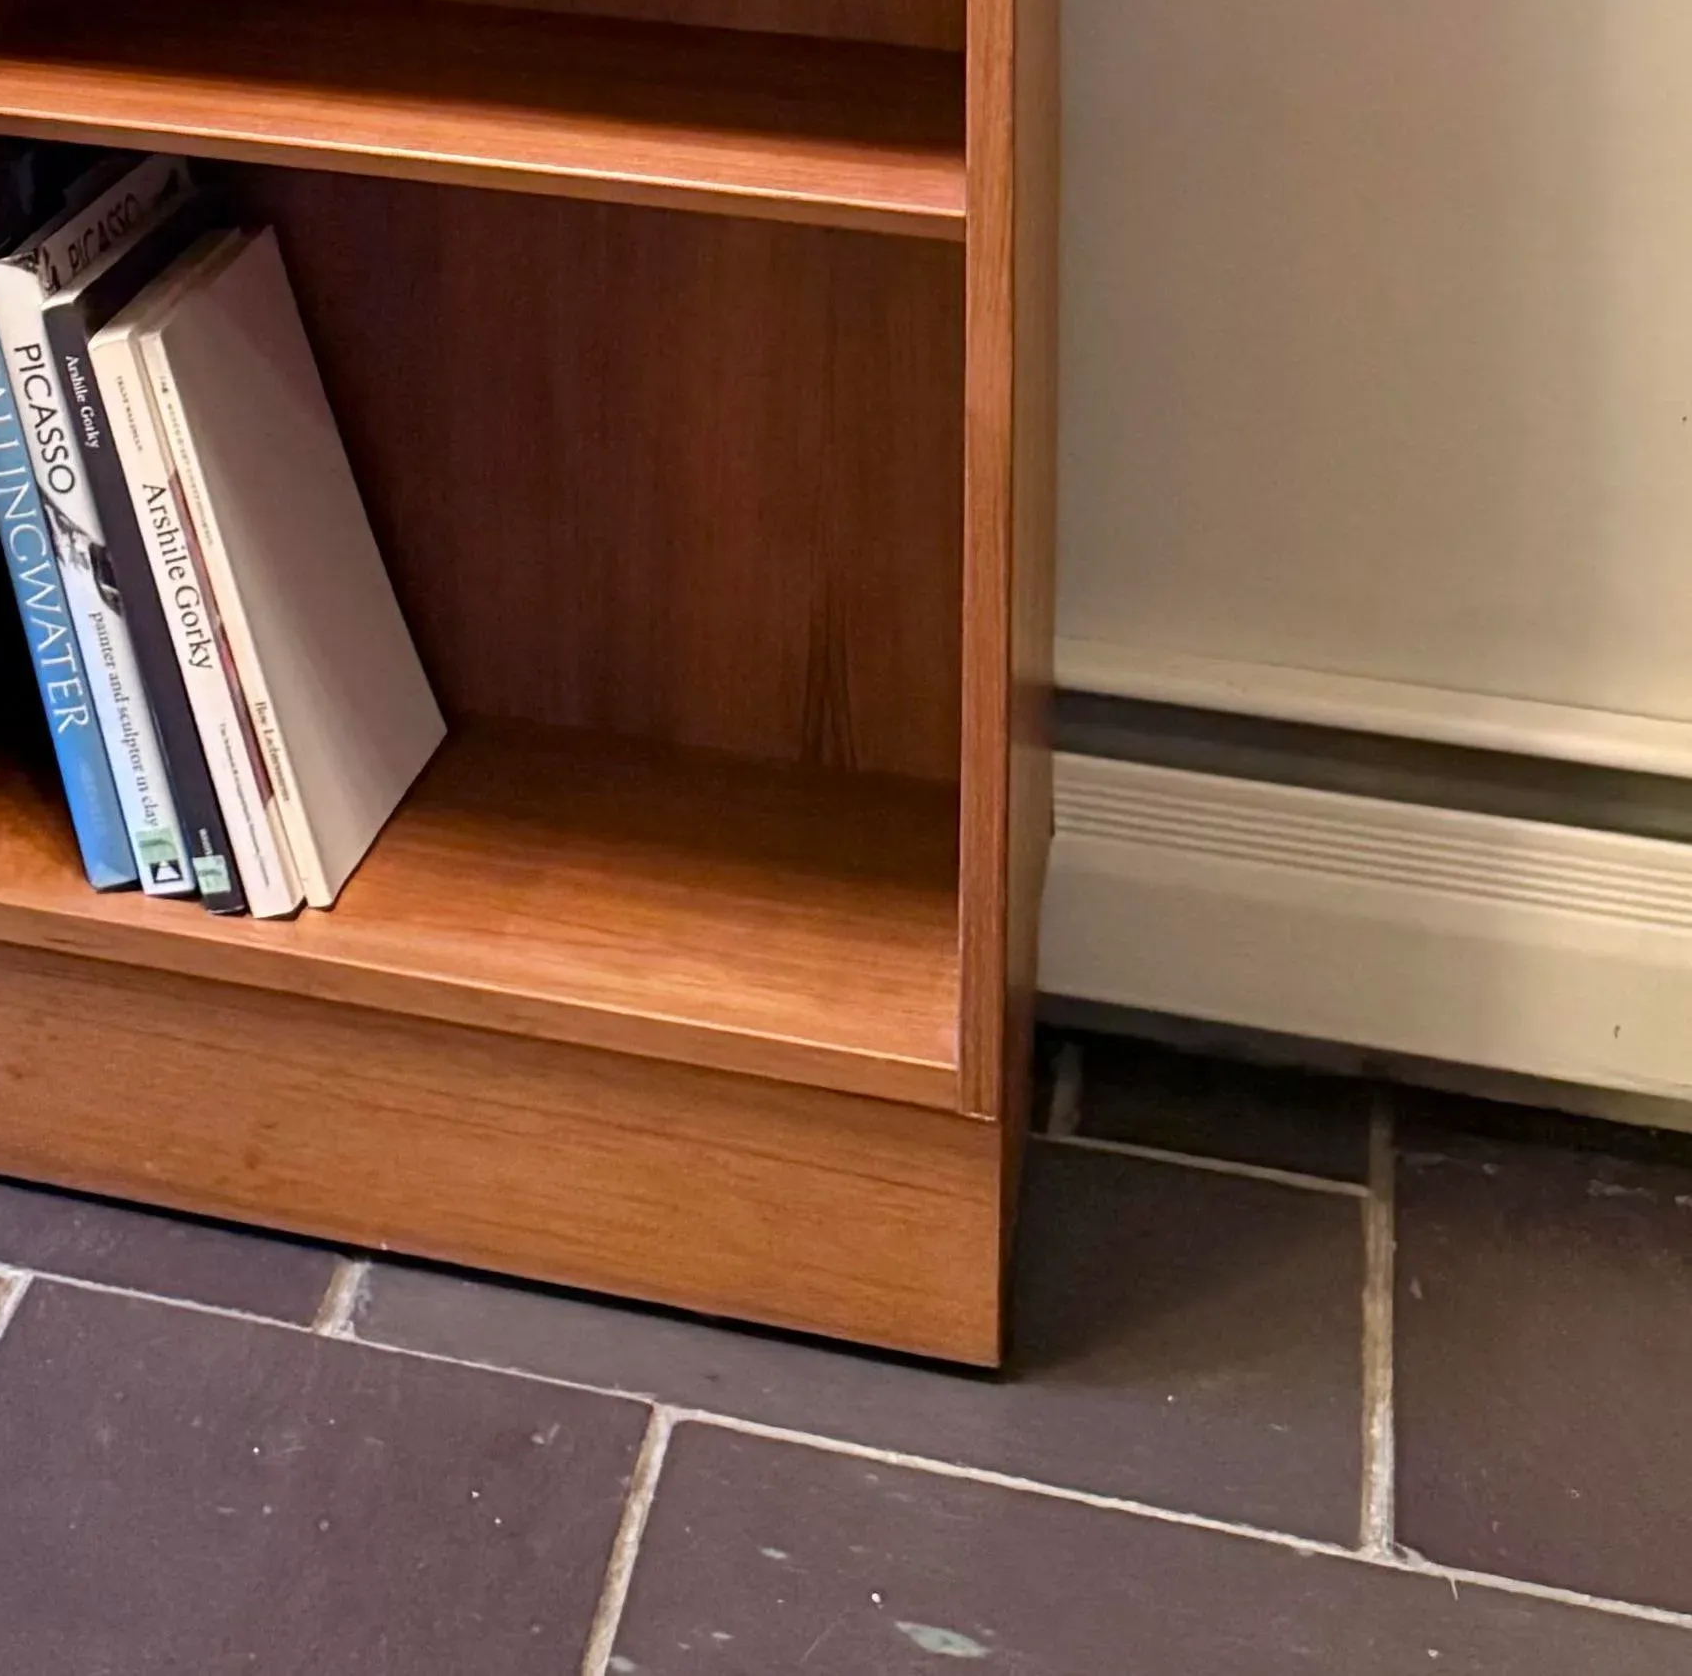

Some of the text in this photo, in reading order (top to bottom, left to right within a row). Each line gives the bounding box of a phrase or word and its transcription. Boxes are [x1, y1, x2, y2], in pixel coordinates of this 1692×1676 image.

[14, 342, 76, 495] PICASSO
[80, 405, 101, 449] Gorky
[142, 482, 189, 582] Arshile
[174, 585, 214, 671] Gorky
[88, 610, 159, 827] painter and sculptor in clay
